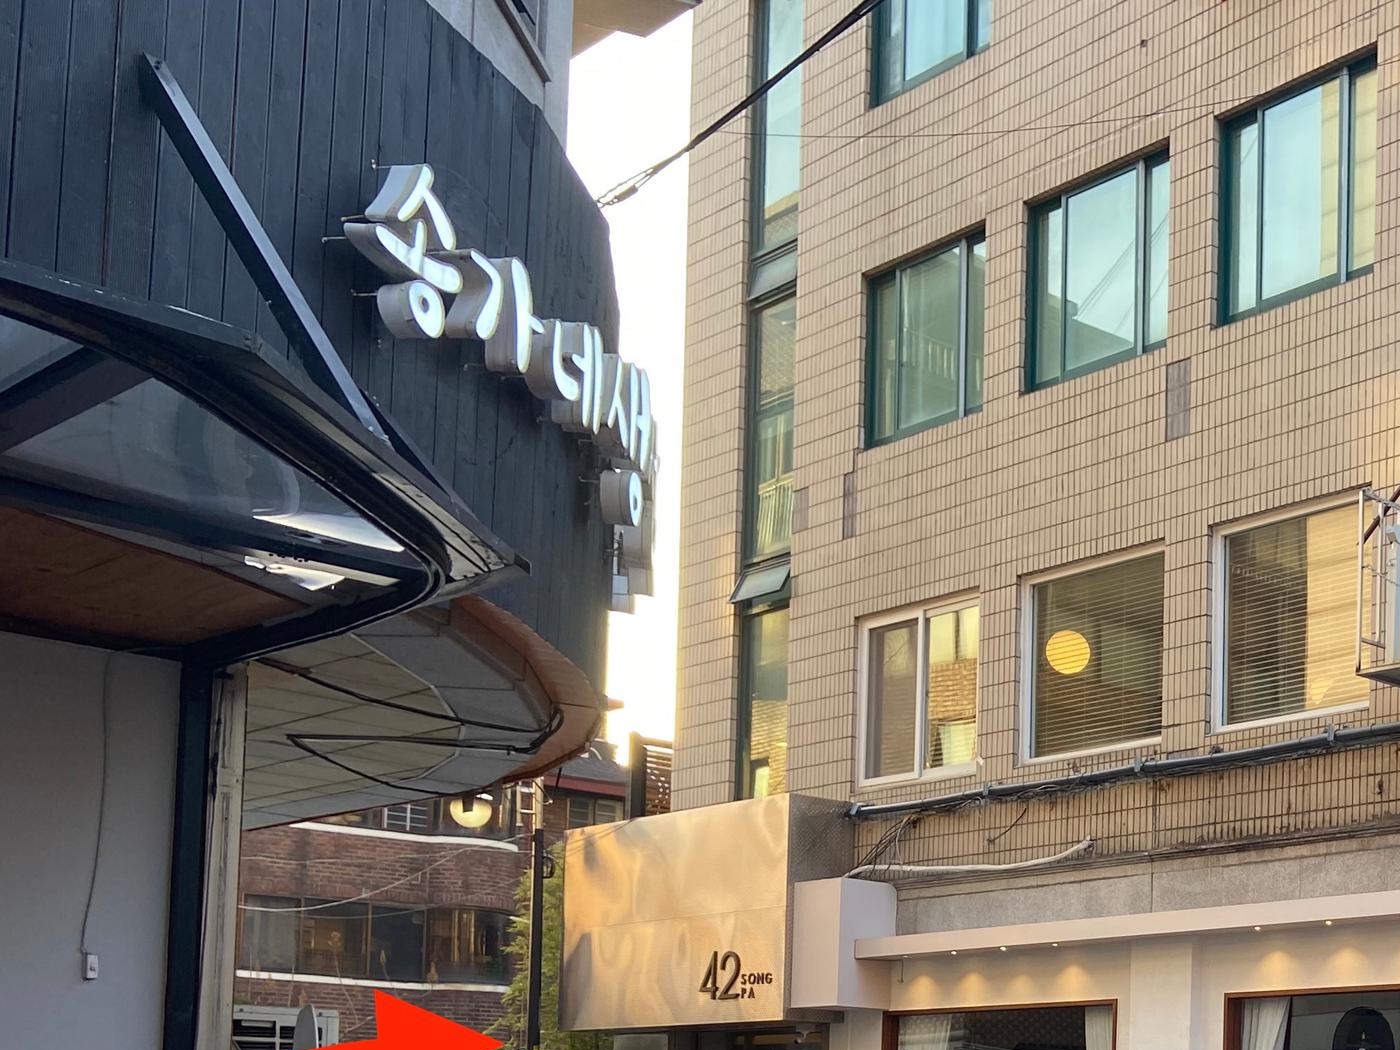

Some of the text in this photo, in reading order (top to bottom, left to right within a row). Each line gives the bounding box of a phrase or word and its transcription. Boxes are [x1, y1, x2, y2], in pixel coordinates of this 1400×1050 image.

[699, 950, 773, 1000] 42 SONG
[741, 988, 755, 999] PA
